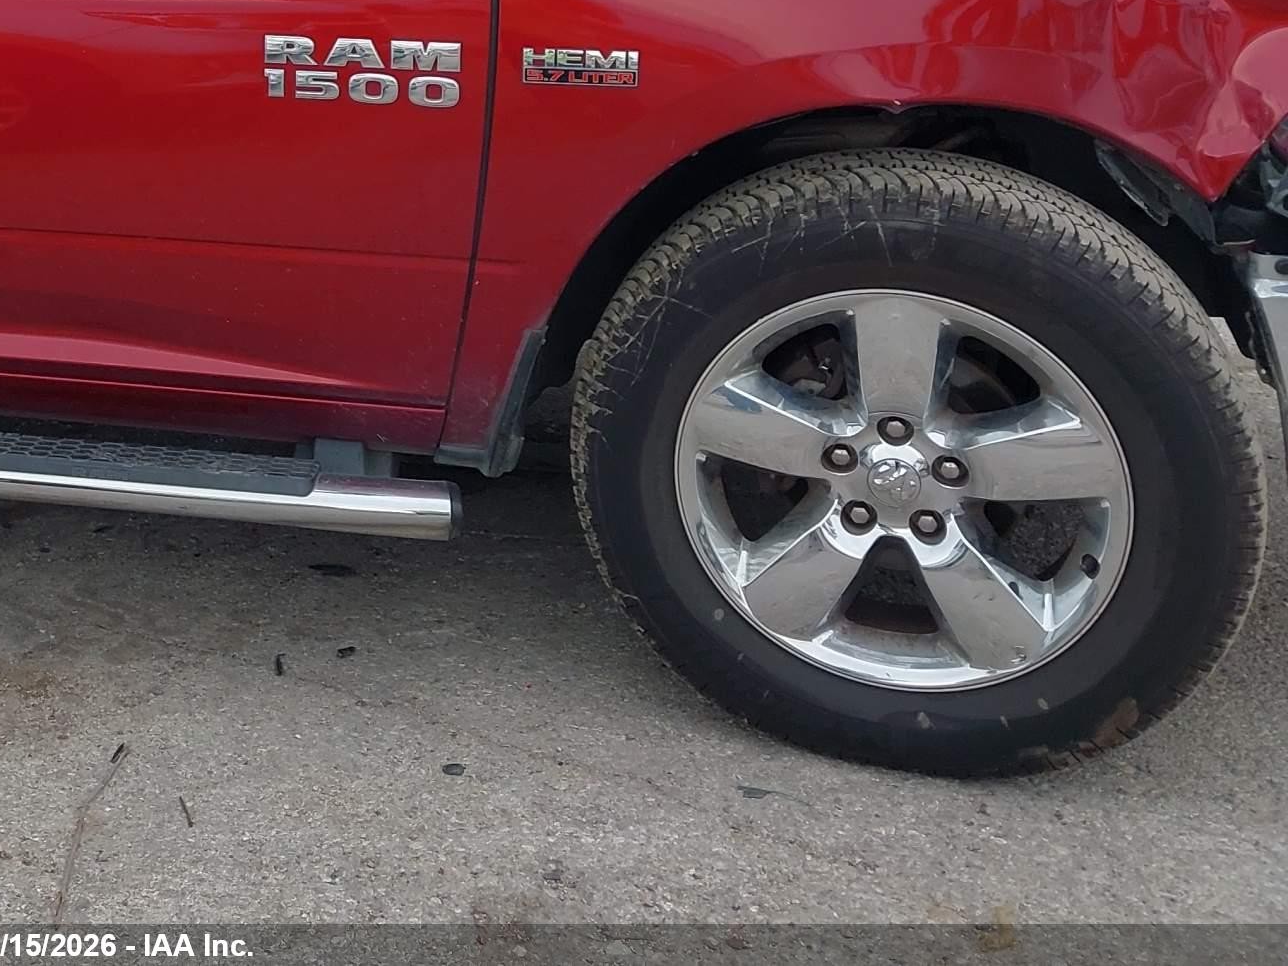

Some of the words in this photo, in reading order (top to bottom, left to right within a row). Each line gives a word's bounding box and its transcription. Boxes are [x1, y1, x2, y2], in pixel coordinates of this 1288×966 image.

[264, 34, 461, 72] RAM
[523, 47, 639, 70] HEMI
[264, 68, 460, 108] 1500
[526, 69, 564, 82] 5.7
[568, 71, 634, 84] LITER
